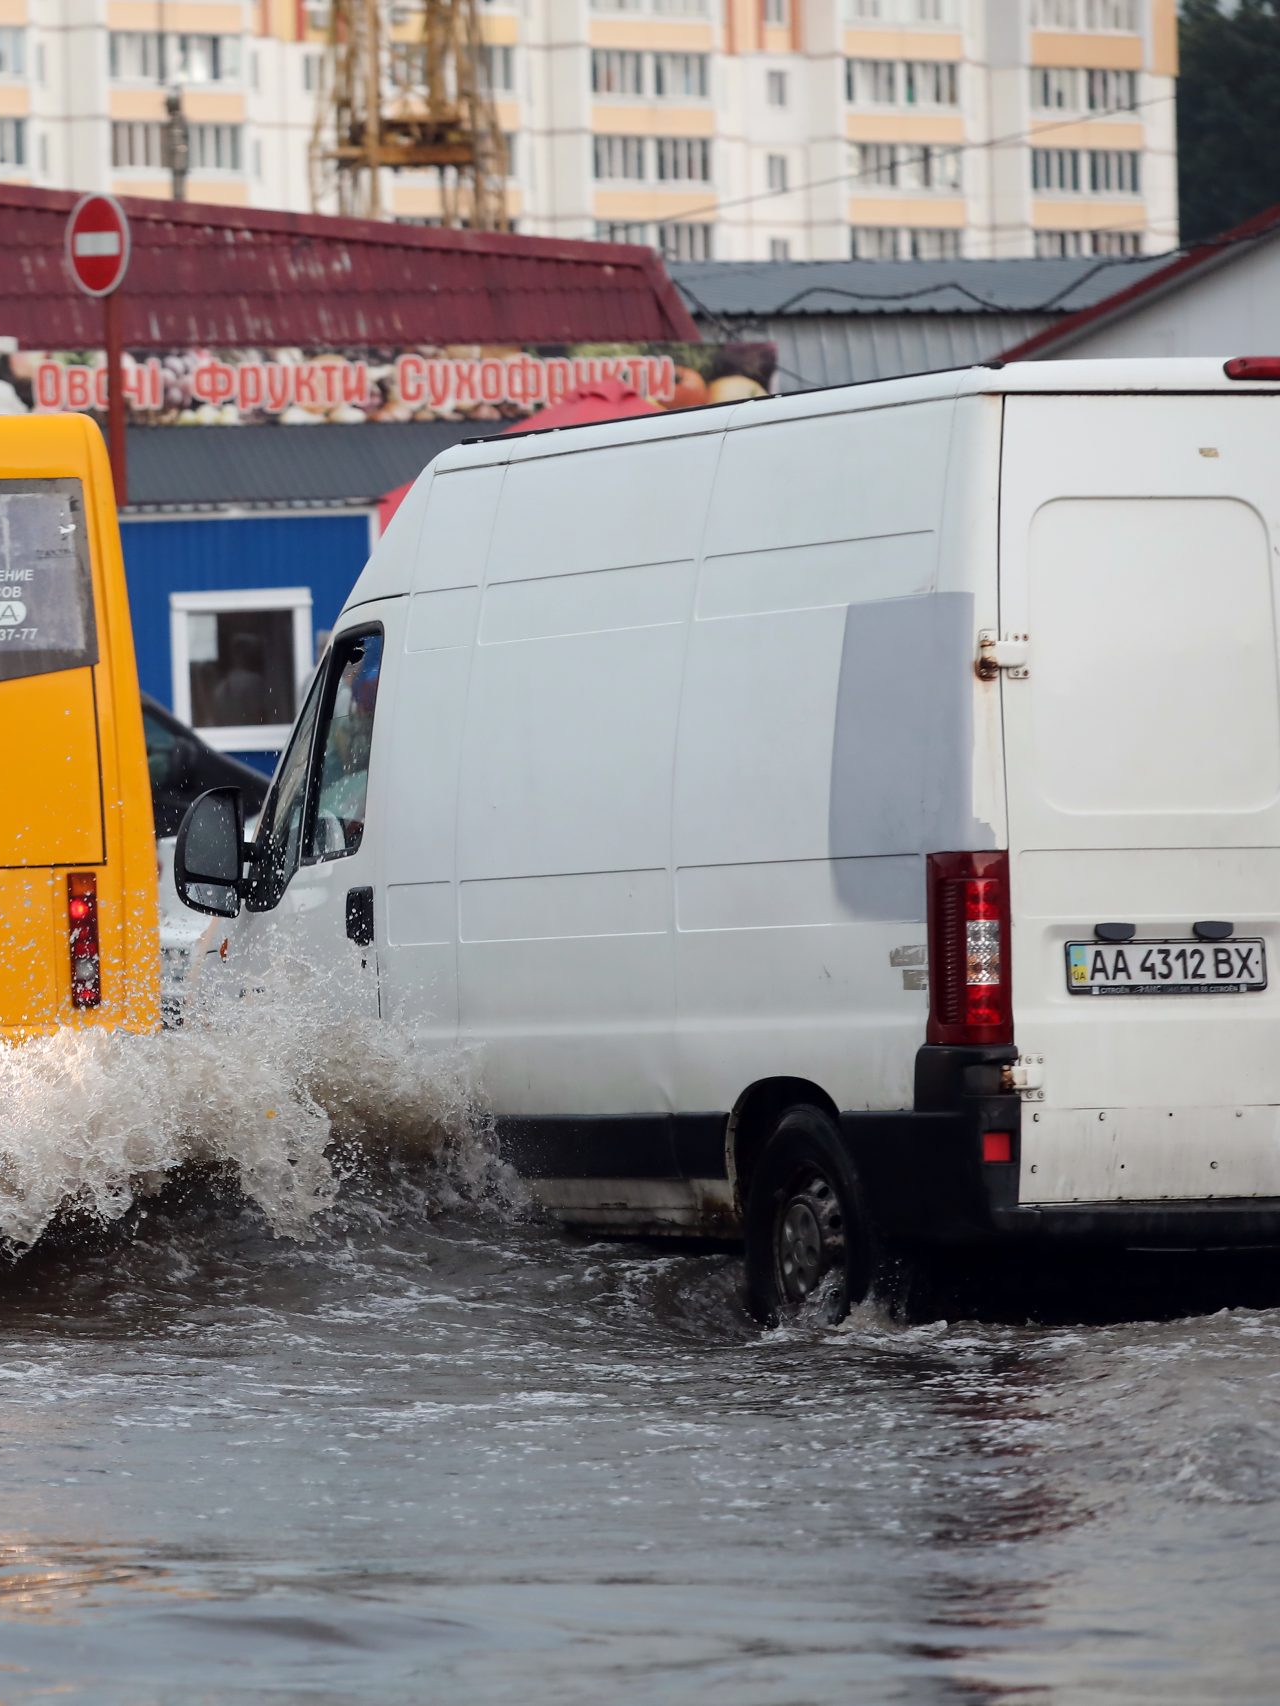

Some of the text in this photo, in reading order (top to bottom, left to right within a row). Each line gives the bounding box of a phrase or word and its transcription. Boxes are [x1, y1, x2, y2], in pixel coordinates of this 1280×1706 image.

[1090, 947, 1256, 981] AA 4312 BX
